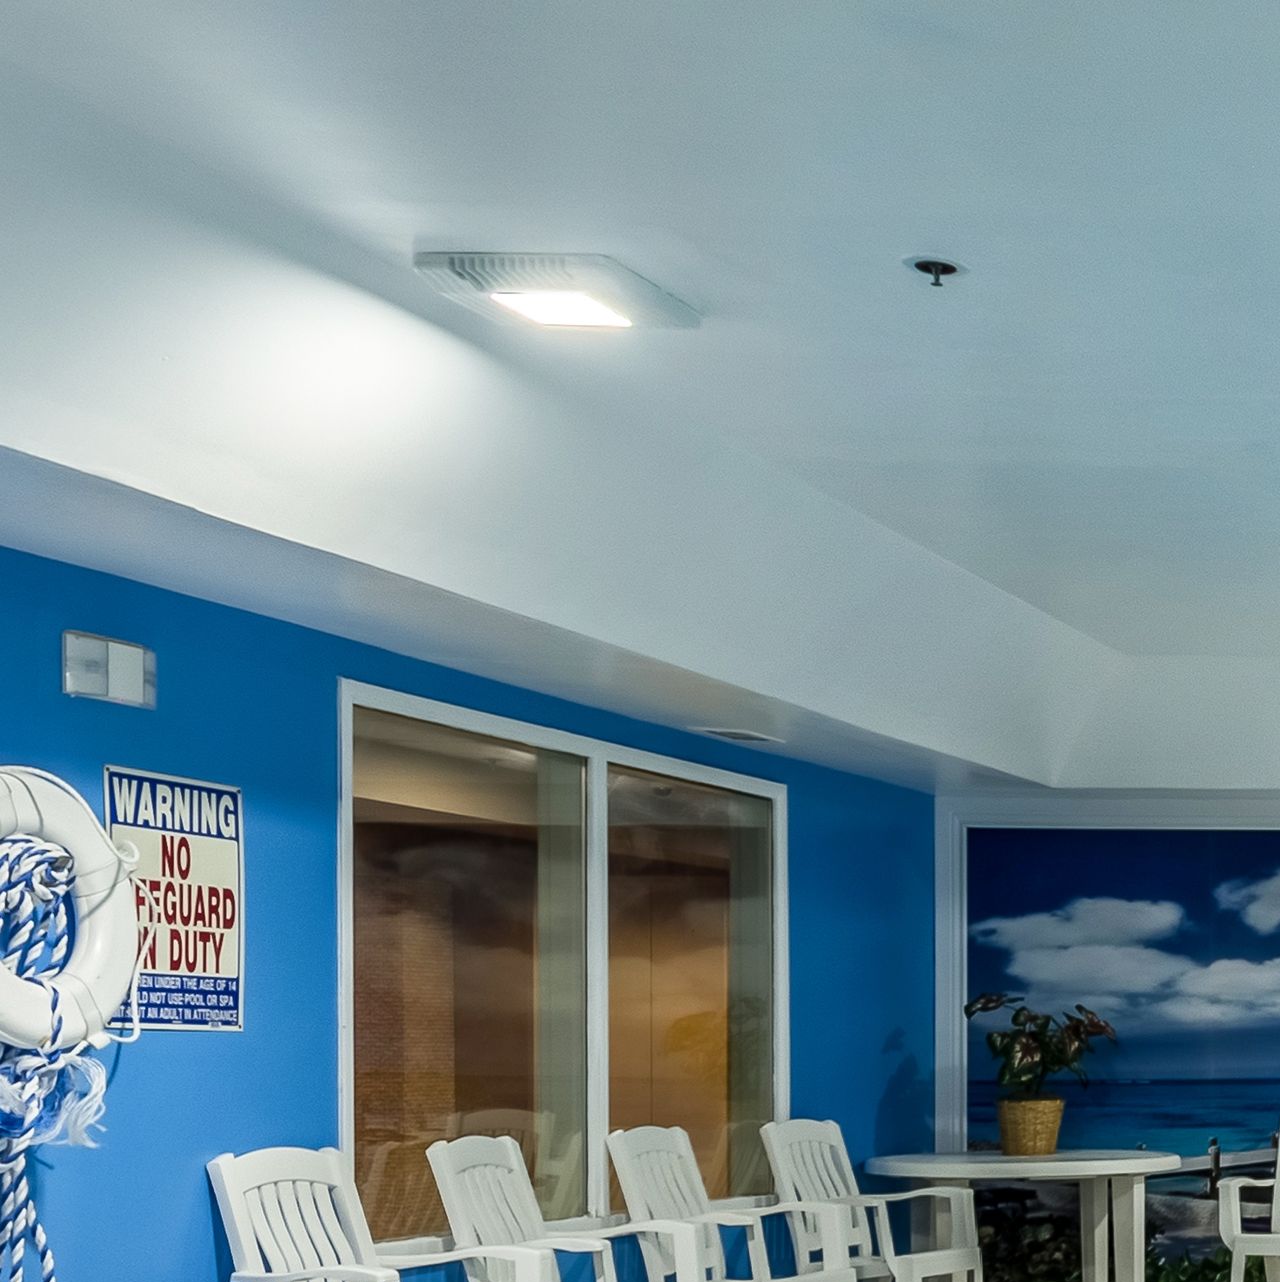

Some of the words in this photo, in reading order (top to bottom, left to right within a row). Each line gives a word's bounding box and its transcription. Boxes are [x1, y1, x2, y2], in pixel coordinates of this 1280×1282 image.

[112, 777, 236, 838] WARNING
[162, 835, 191, 880] NO
[132, 878, 236, 930] FEGUARD
[170, 929, 224, 974] DUTY
[149, 991, 166, 1004] NOT
[206, 994, 217, 1006] OR
[219, 995, 233, 1007] SPA
[155, 976, 181, 989] UNDER
[183, 977, 197, 990] THE
[199, 978, 215, 991] AGE
[216, 980, 226, 991] OF
[159, 1008, 183, 1020] ADULT
[192, 1009, 237, 1021] ATTENDANCE
